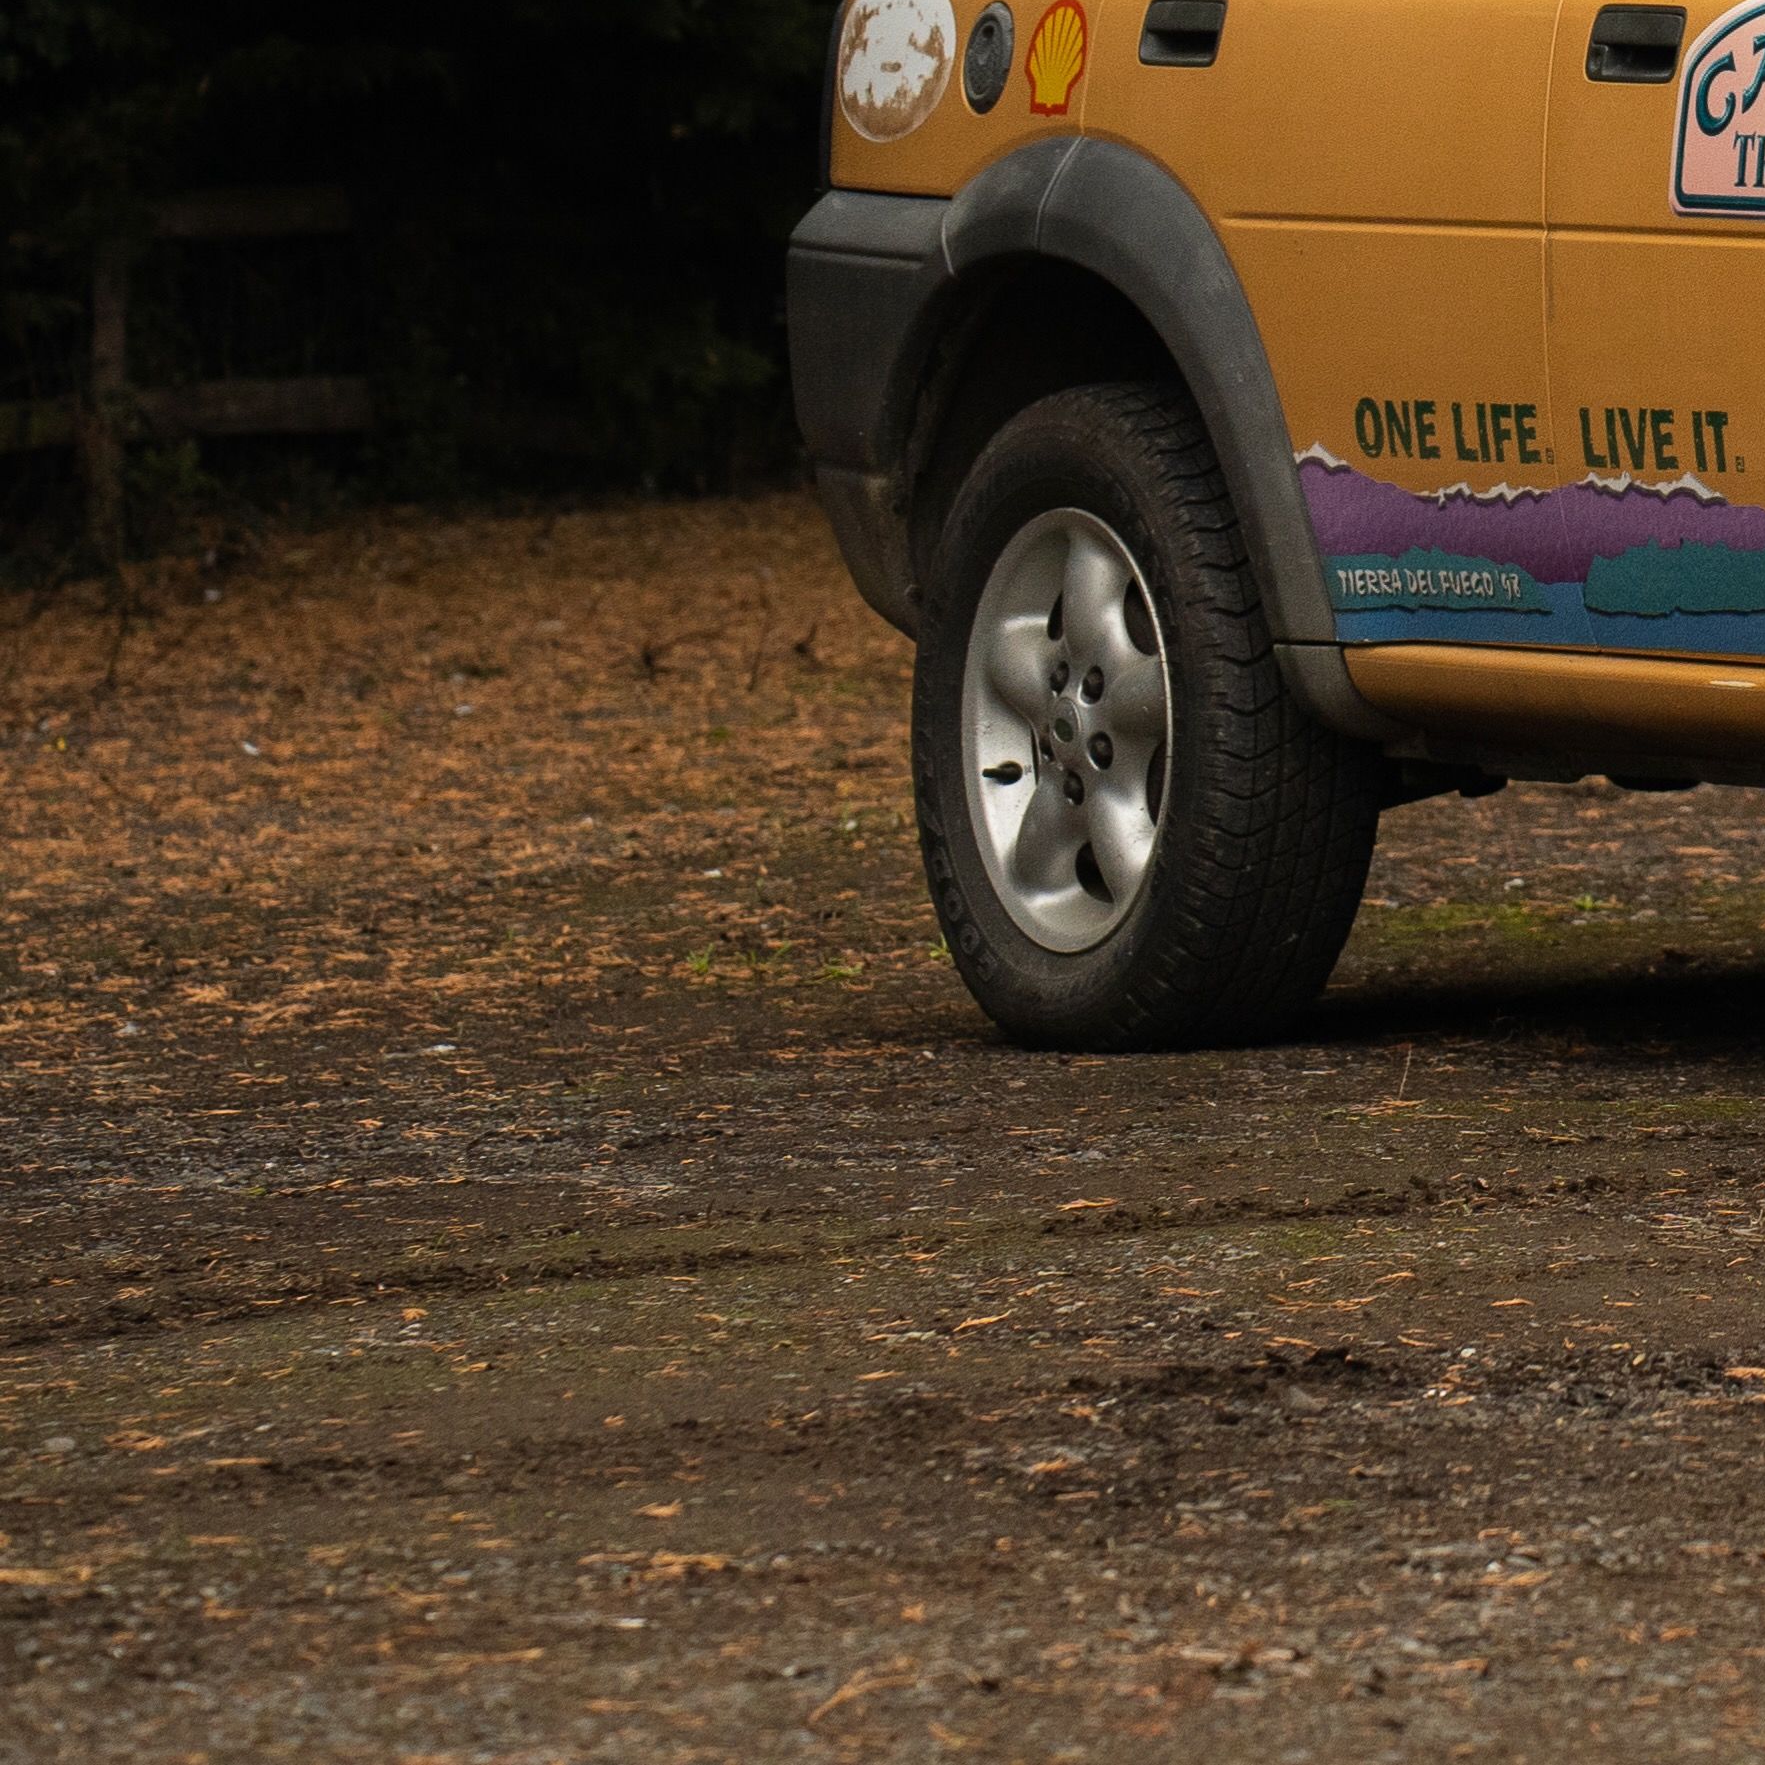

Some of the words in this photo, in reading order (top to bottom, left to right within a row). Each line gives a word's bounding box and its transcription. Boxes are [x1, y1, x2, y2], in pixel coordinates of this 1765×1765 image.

[1354, 397, 1441, 459] ONE
[1579, 406, 1680, 471] LIVE
[1337, 568, 1402, 597] TIERRA
[1403, 568, 1438, 595] DEL
[1438, 570, 1494, 598] FUEGO
